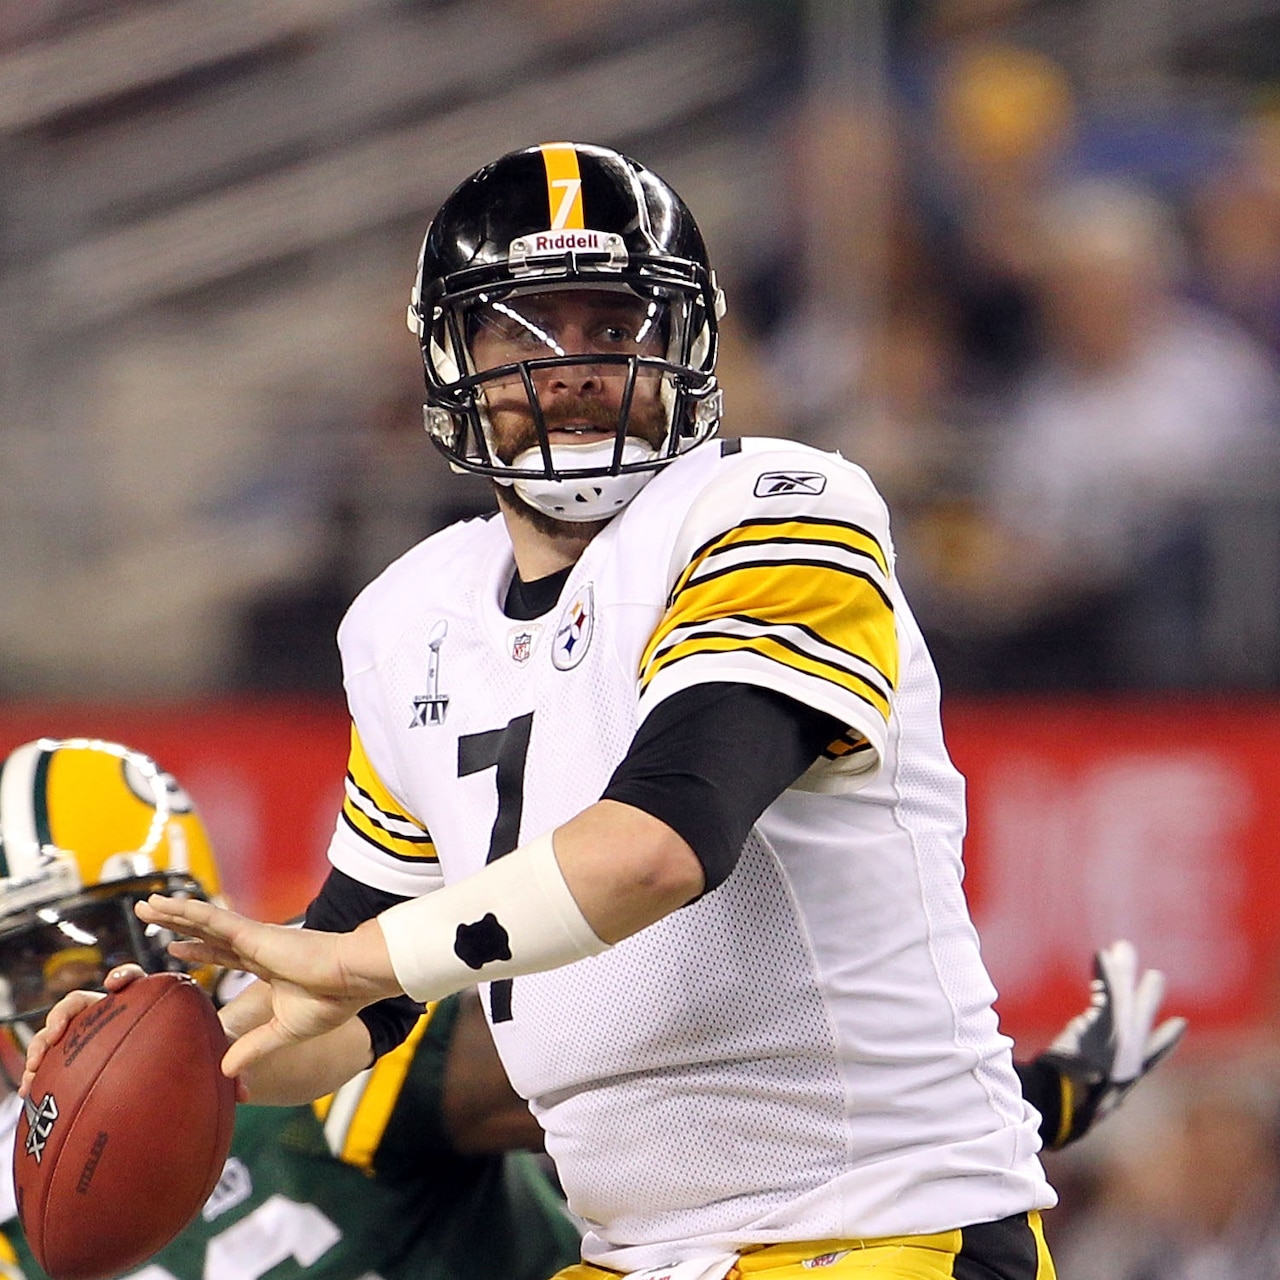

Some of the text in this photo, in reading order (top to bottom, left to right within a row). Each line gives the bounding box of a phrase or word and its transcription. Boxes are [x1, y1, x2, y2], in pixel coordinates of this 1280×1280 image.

[551, 178, 582, 230] 7
[536, 234, 599, 251] Riddell
[408, 700, 451, 729] XLV
[456, 709, 536, 1024] 7
[27, 1093, 60, 1164] XLV
